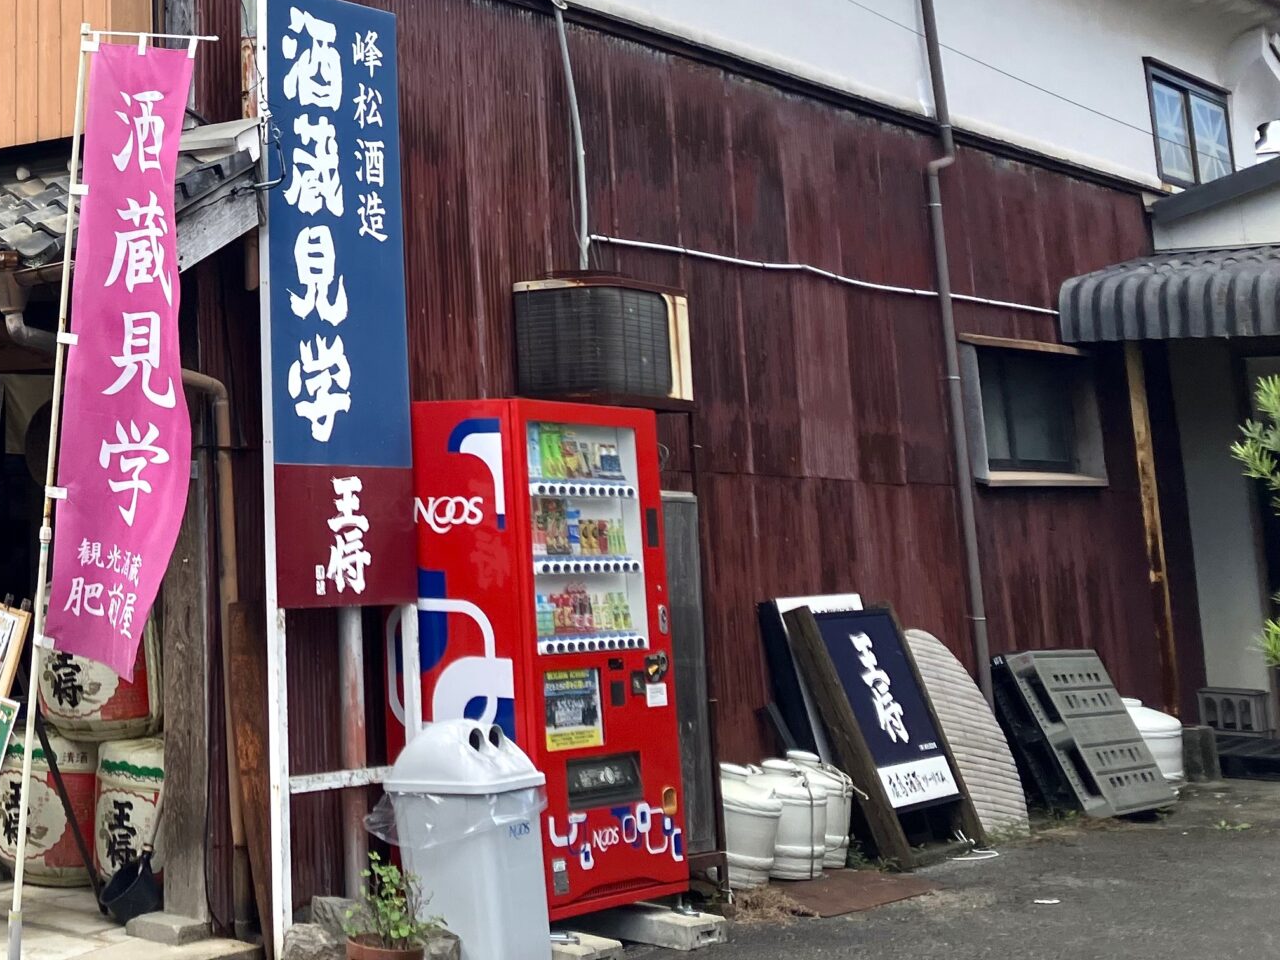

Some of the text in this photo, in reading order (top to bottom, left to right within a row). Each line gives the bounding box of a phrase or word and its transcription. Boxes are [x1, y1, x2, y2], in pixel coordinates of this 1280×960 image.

[352, 30, 389, 242] 峰松酒造
[283, 6, 352, 442] 酒蔵見学
[99, 90, 176, 527] 酒蔵見学
[326, 476, 371, 594] 王将
[413, 496, 483, 534] NOOS
[63, 576, 138, 640] 肥前屋
[593, 827, 620, 852] NOOS
